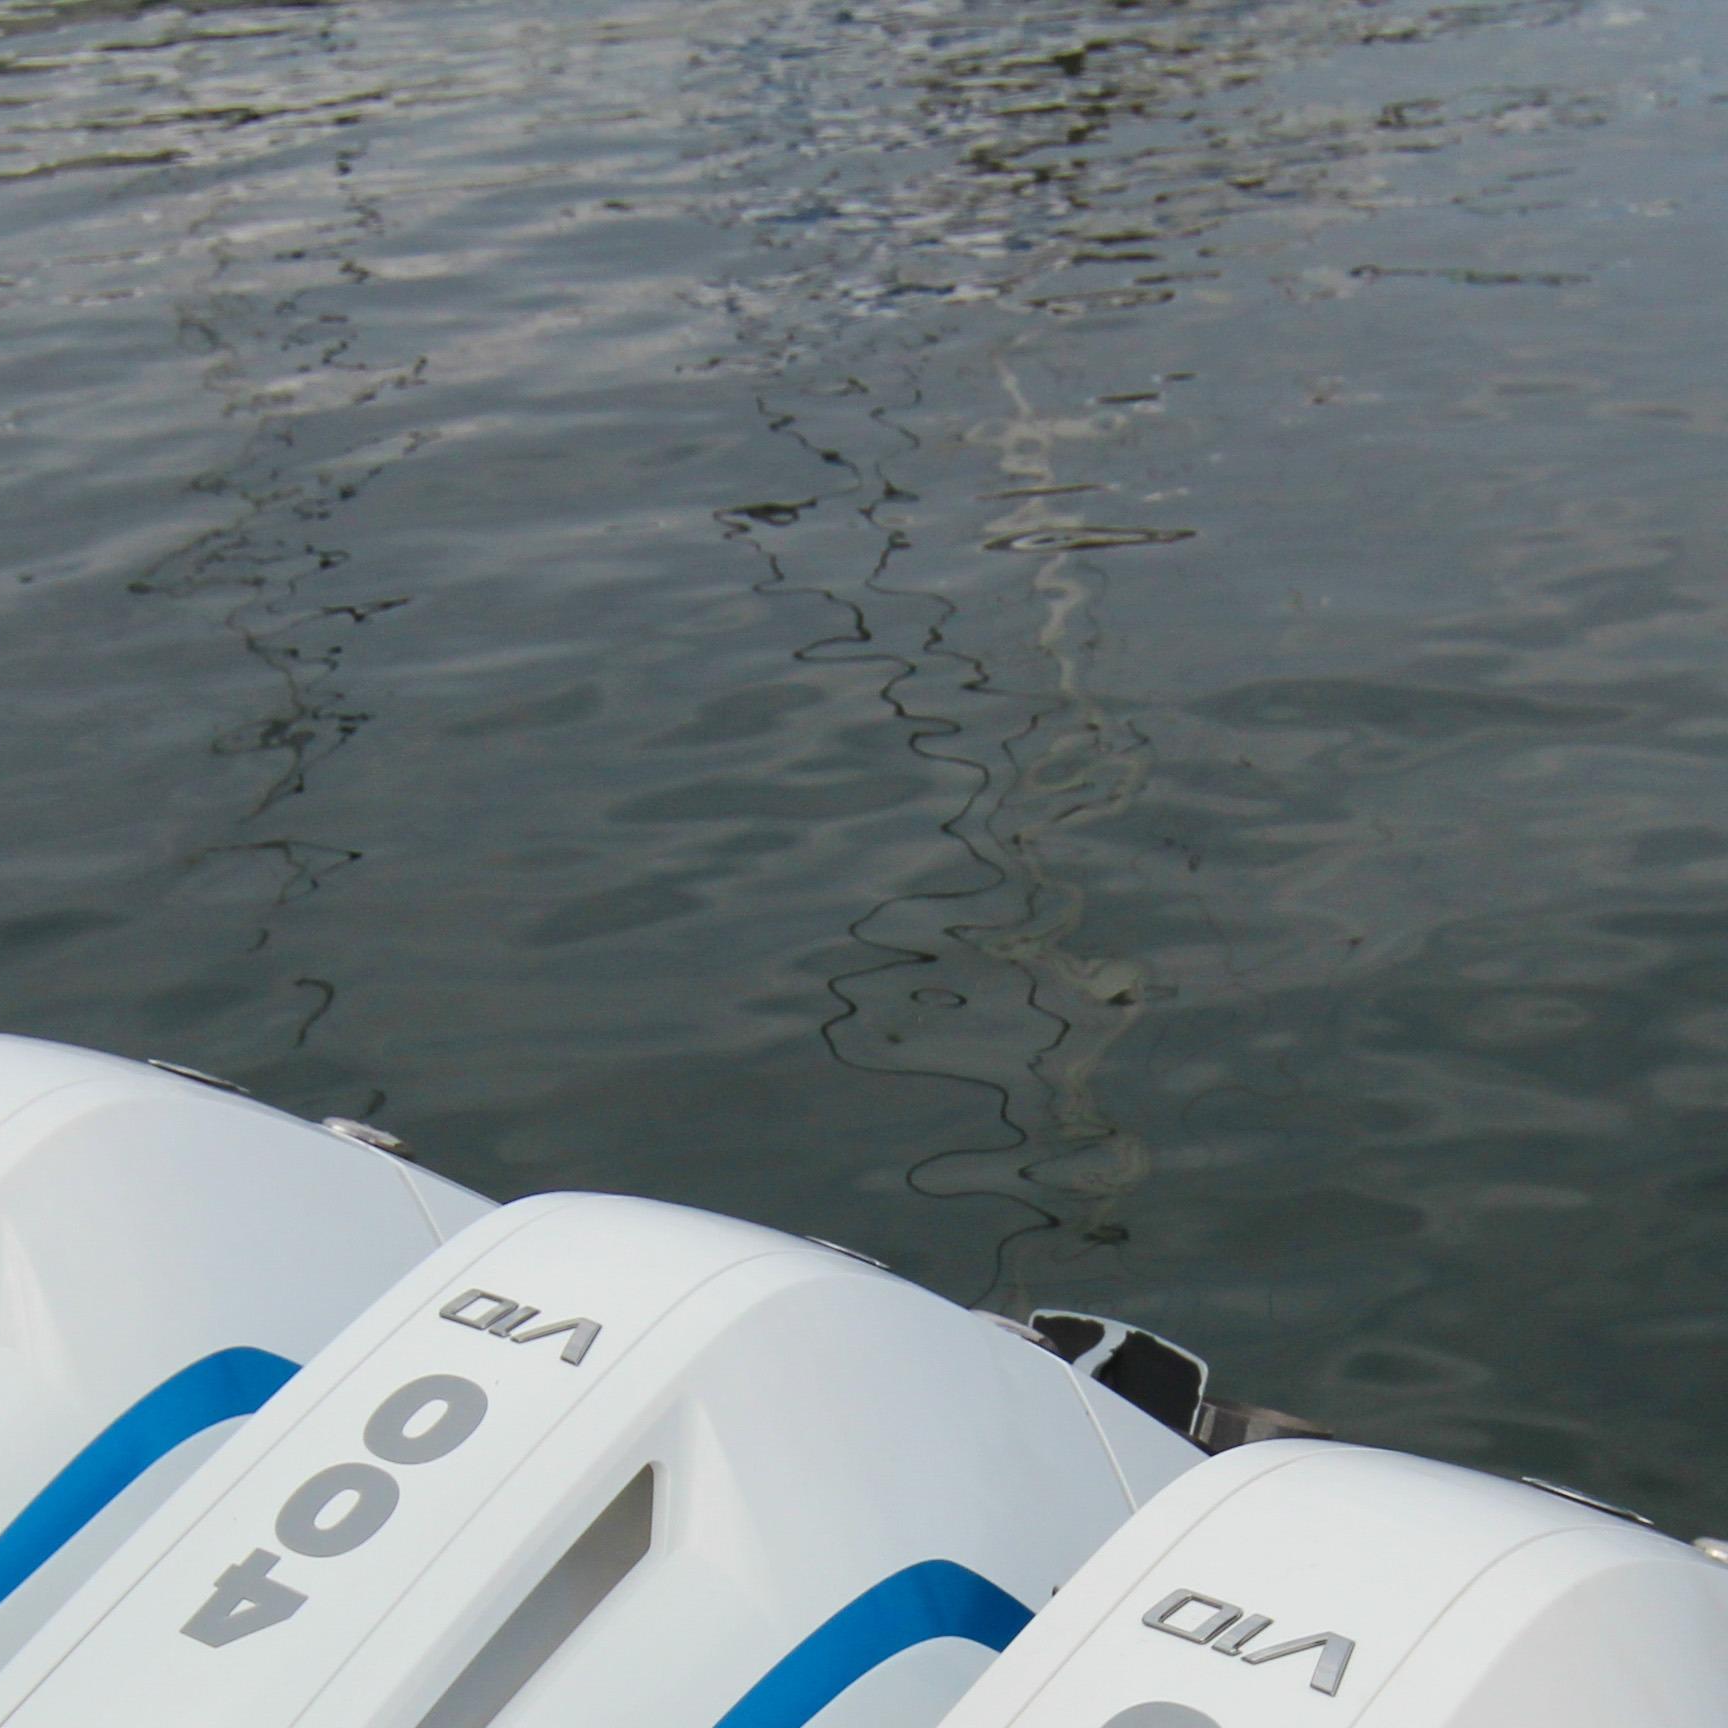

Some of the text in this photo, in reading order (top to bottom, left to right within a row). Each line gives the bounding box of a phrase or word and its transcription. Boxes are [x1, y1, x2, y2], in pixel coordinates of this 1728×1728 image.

[439, 1289, 602, 1366] V10
[179, 1374, 488, 1648] 400
[1142, 1588, 1357, 1697] V10
